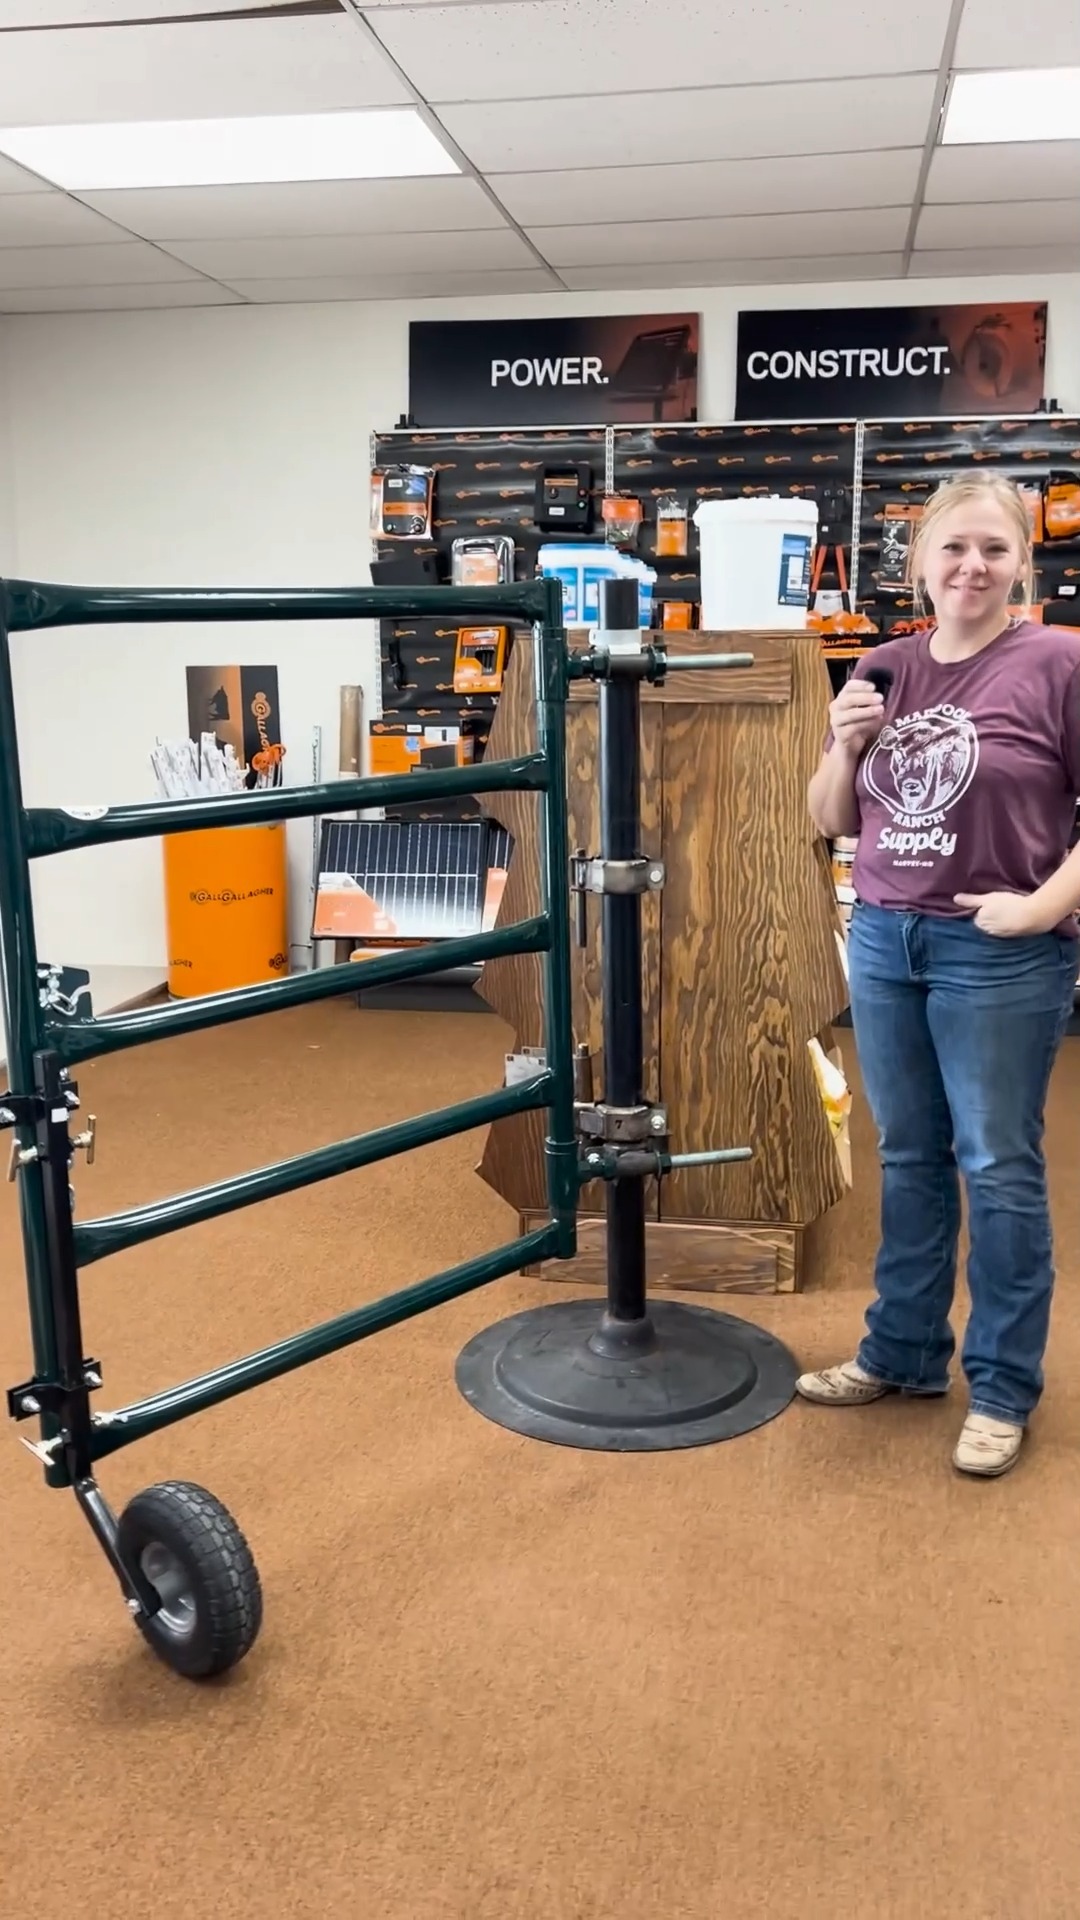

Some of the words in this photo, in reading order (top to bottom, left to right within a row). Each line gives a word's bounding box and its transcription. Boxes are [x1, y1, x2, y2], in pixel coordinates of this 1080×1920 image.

[490, 356, 609, 387] POWER.
[746, 345, 951, 380] CONSTRUCT.
[892, 809, 946, 829] RANCH
[876, 826, 958, 857] Supply
[614, 1119, 623, 1130] 7
